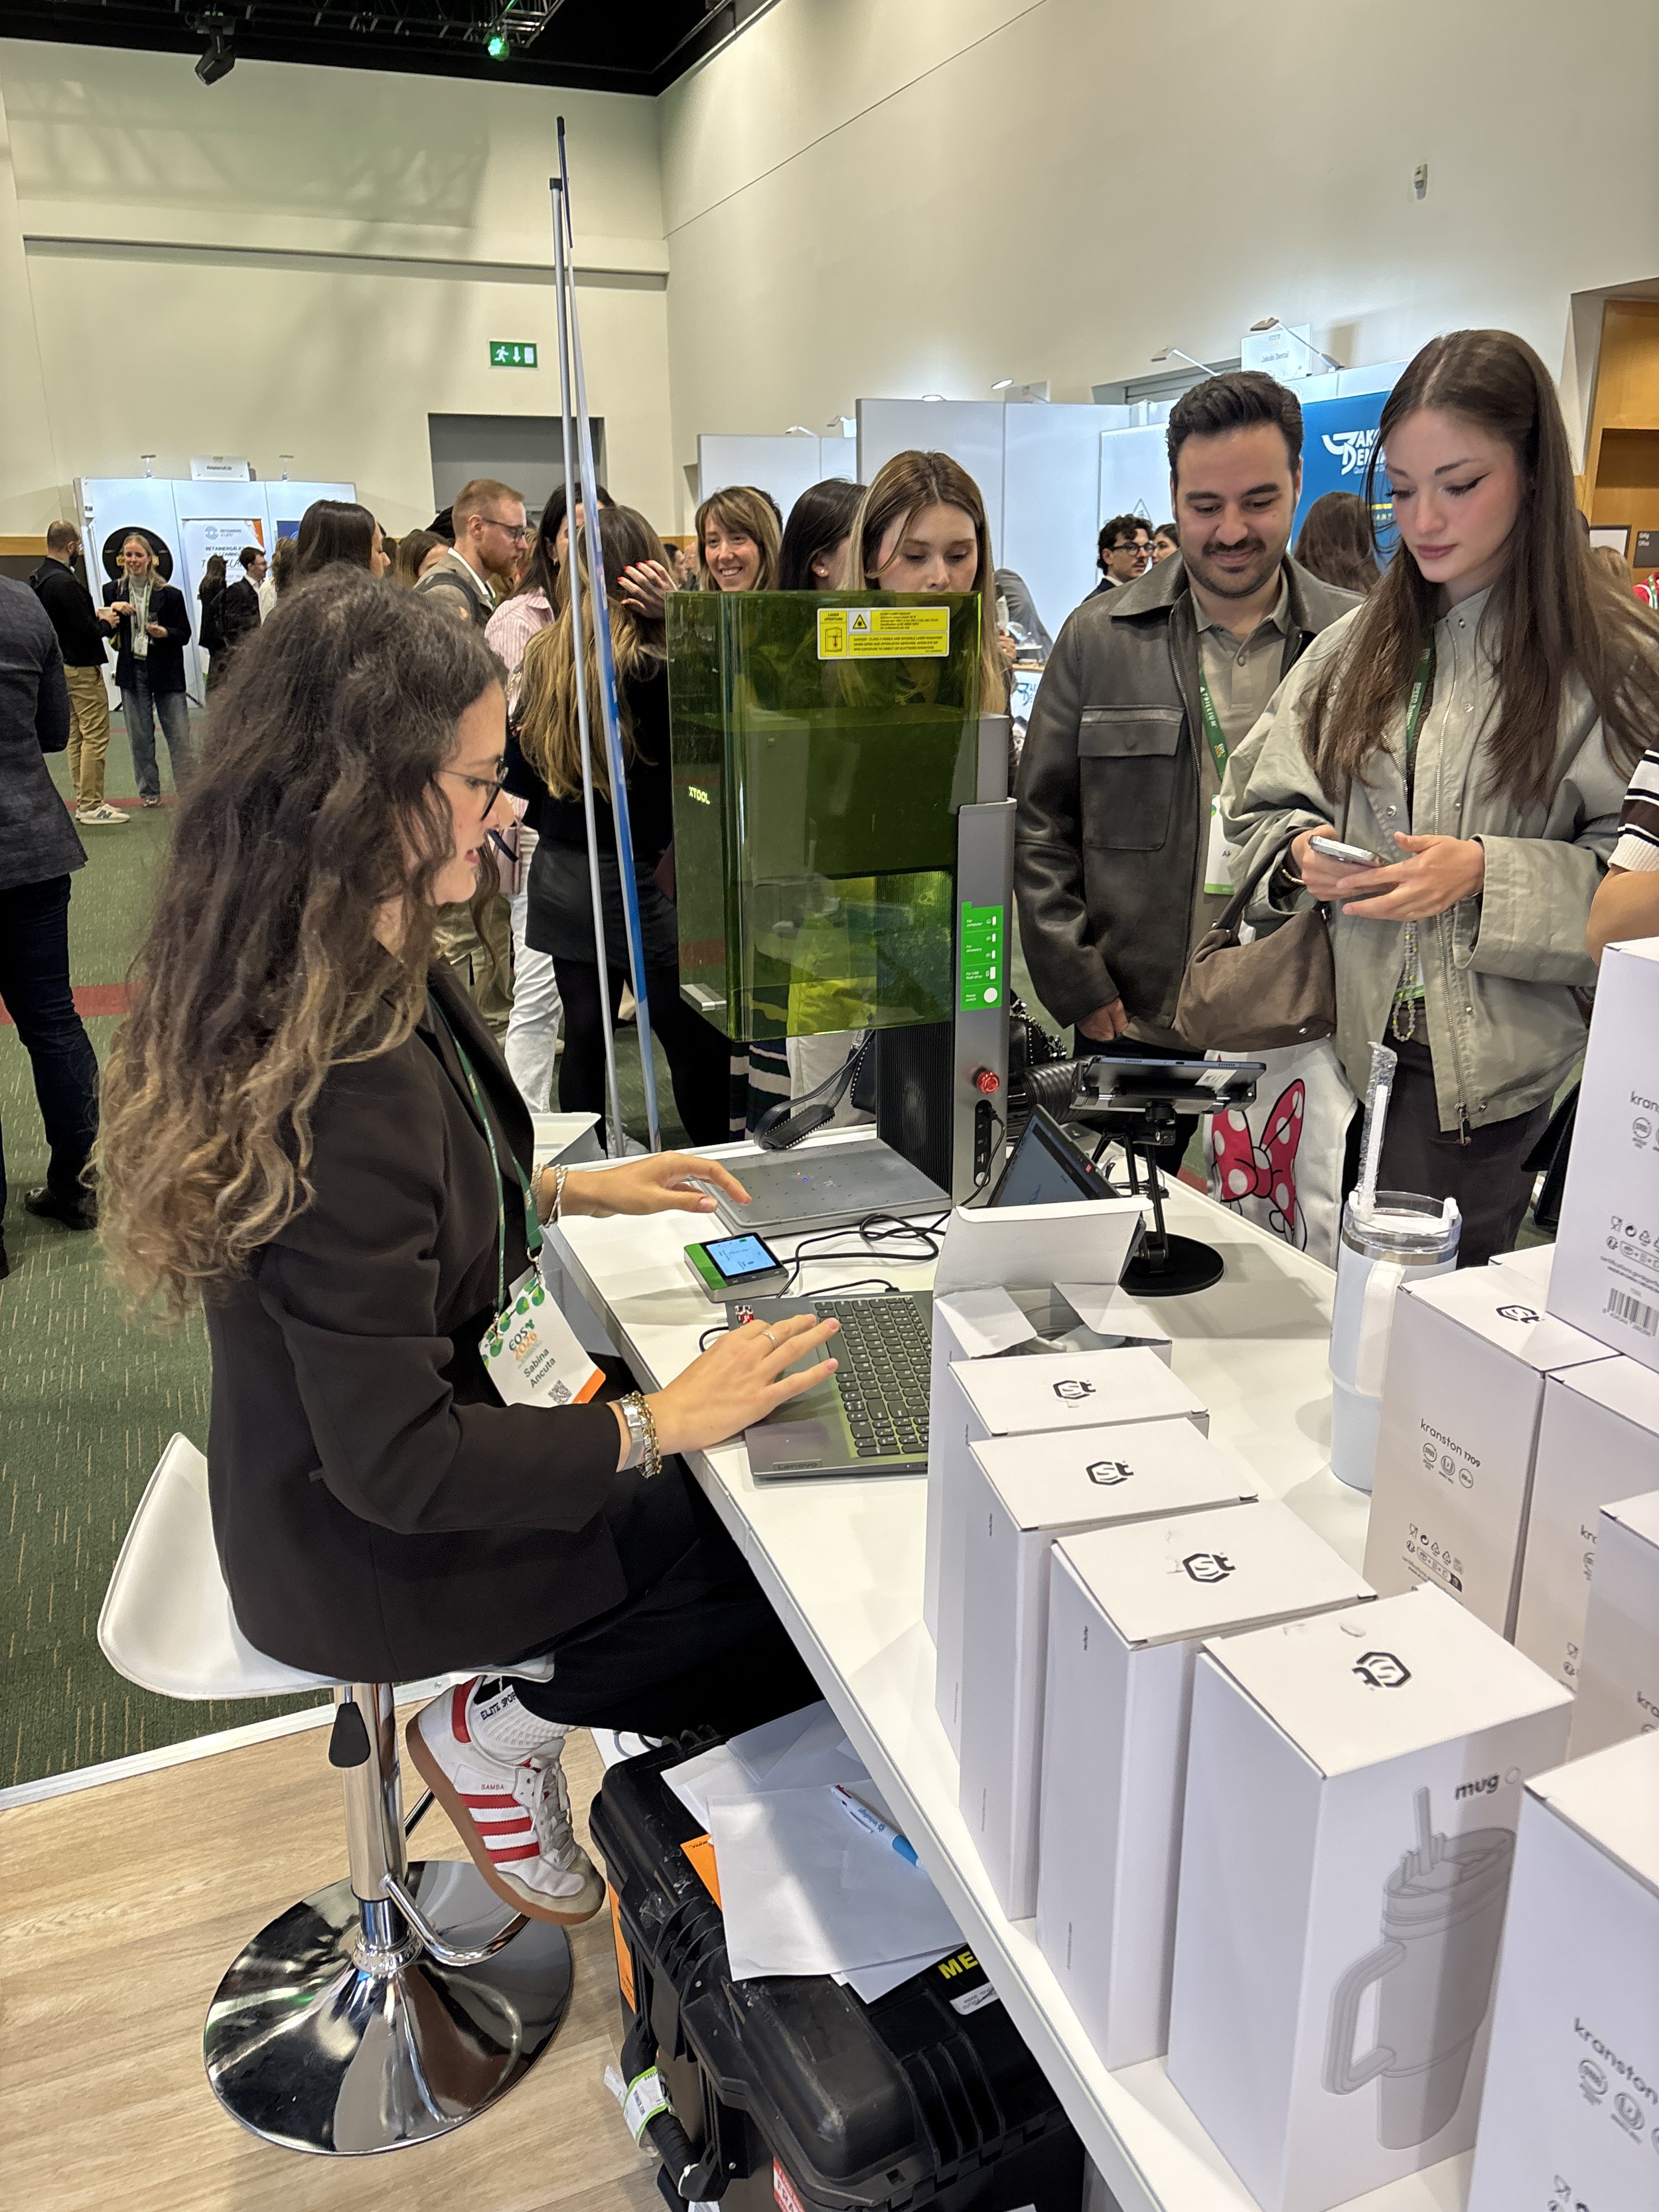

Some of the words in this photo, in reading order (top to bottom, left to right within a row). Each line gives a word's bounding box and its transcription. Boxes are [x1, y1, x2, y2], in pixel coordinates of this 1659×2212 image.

[508, 1327, 528, 1352] EOS
[514, 1331, 538, 1361] 2026
[524, 1348, 549, 1378] Sabina
[530, 1358, 557, 1388] Ancuta
[1420, 1418, 1462, 1456] kranston
[1464, 1451, 1480, 1468] 1709
[480, 1702, 500, 1721] ELITE
[1455, 1774, 1500, 1801] mug
[938, 1951, 979, 1980] ME
[1573, 2017, 1658, 2105] kranston
